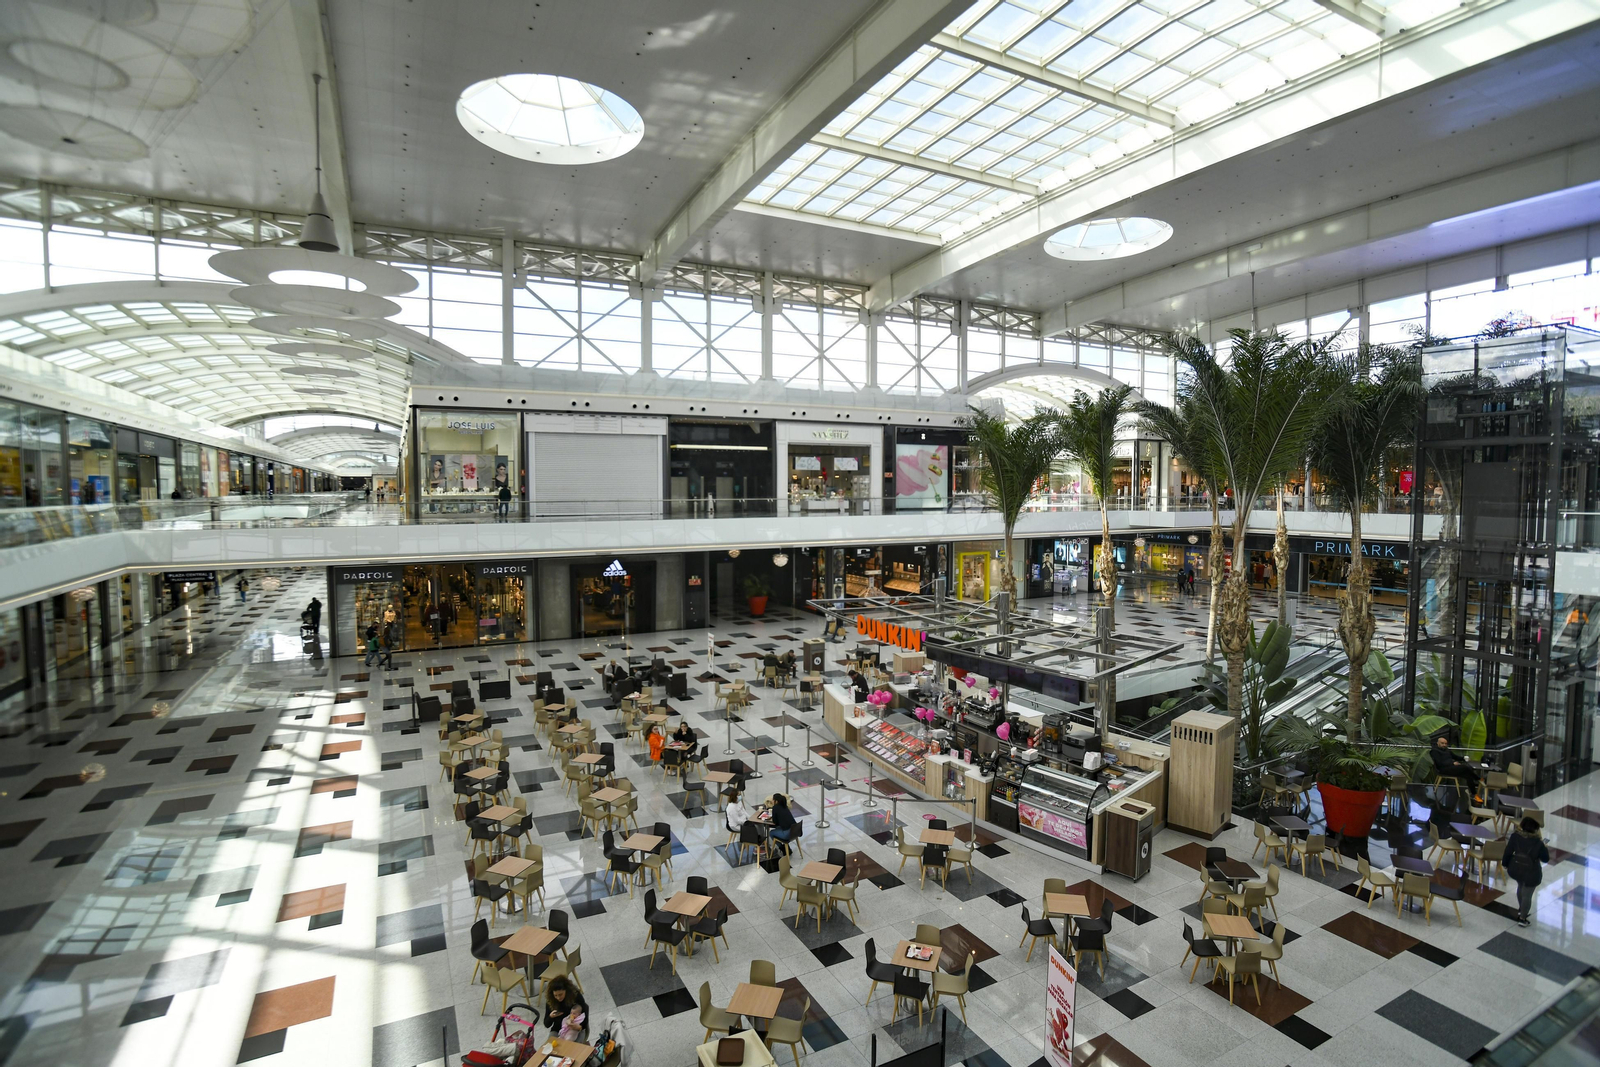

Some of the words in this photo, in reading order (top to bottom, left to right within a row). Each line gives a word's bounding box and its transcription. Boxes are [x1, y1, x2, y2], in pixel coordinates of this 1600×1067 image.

[475, 422, 496, 430] LUIS
[1315, 541, 1395, 557] PRIMARK
[343, 571, 393, 580] PARFOIS
[482, 565, 527, 574] PARFOIS
[857, 614, 927, 653] DUNKIN'
[1055, 823, 1083, 837] DEJAMOS
[1056, 984, 1065, 996] UNA
[1047, 986, 1057, 1000] PARA
[1056, 997, 1074, 1019] REGALAR
